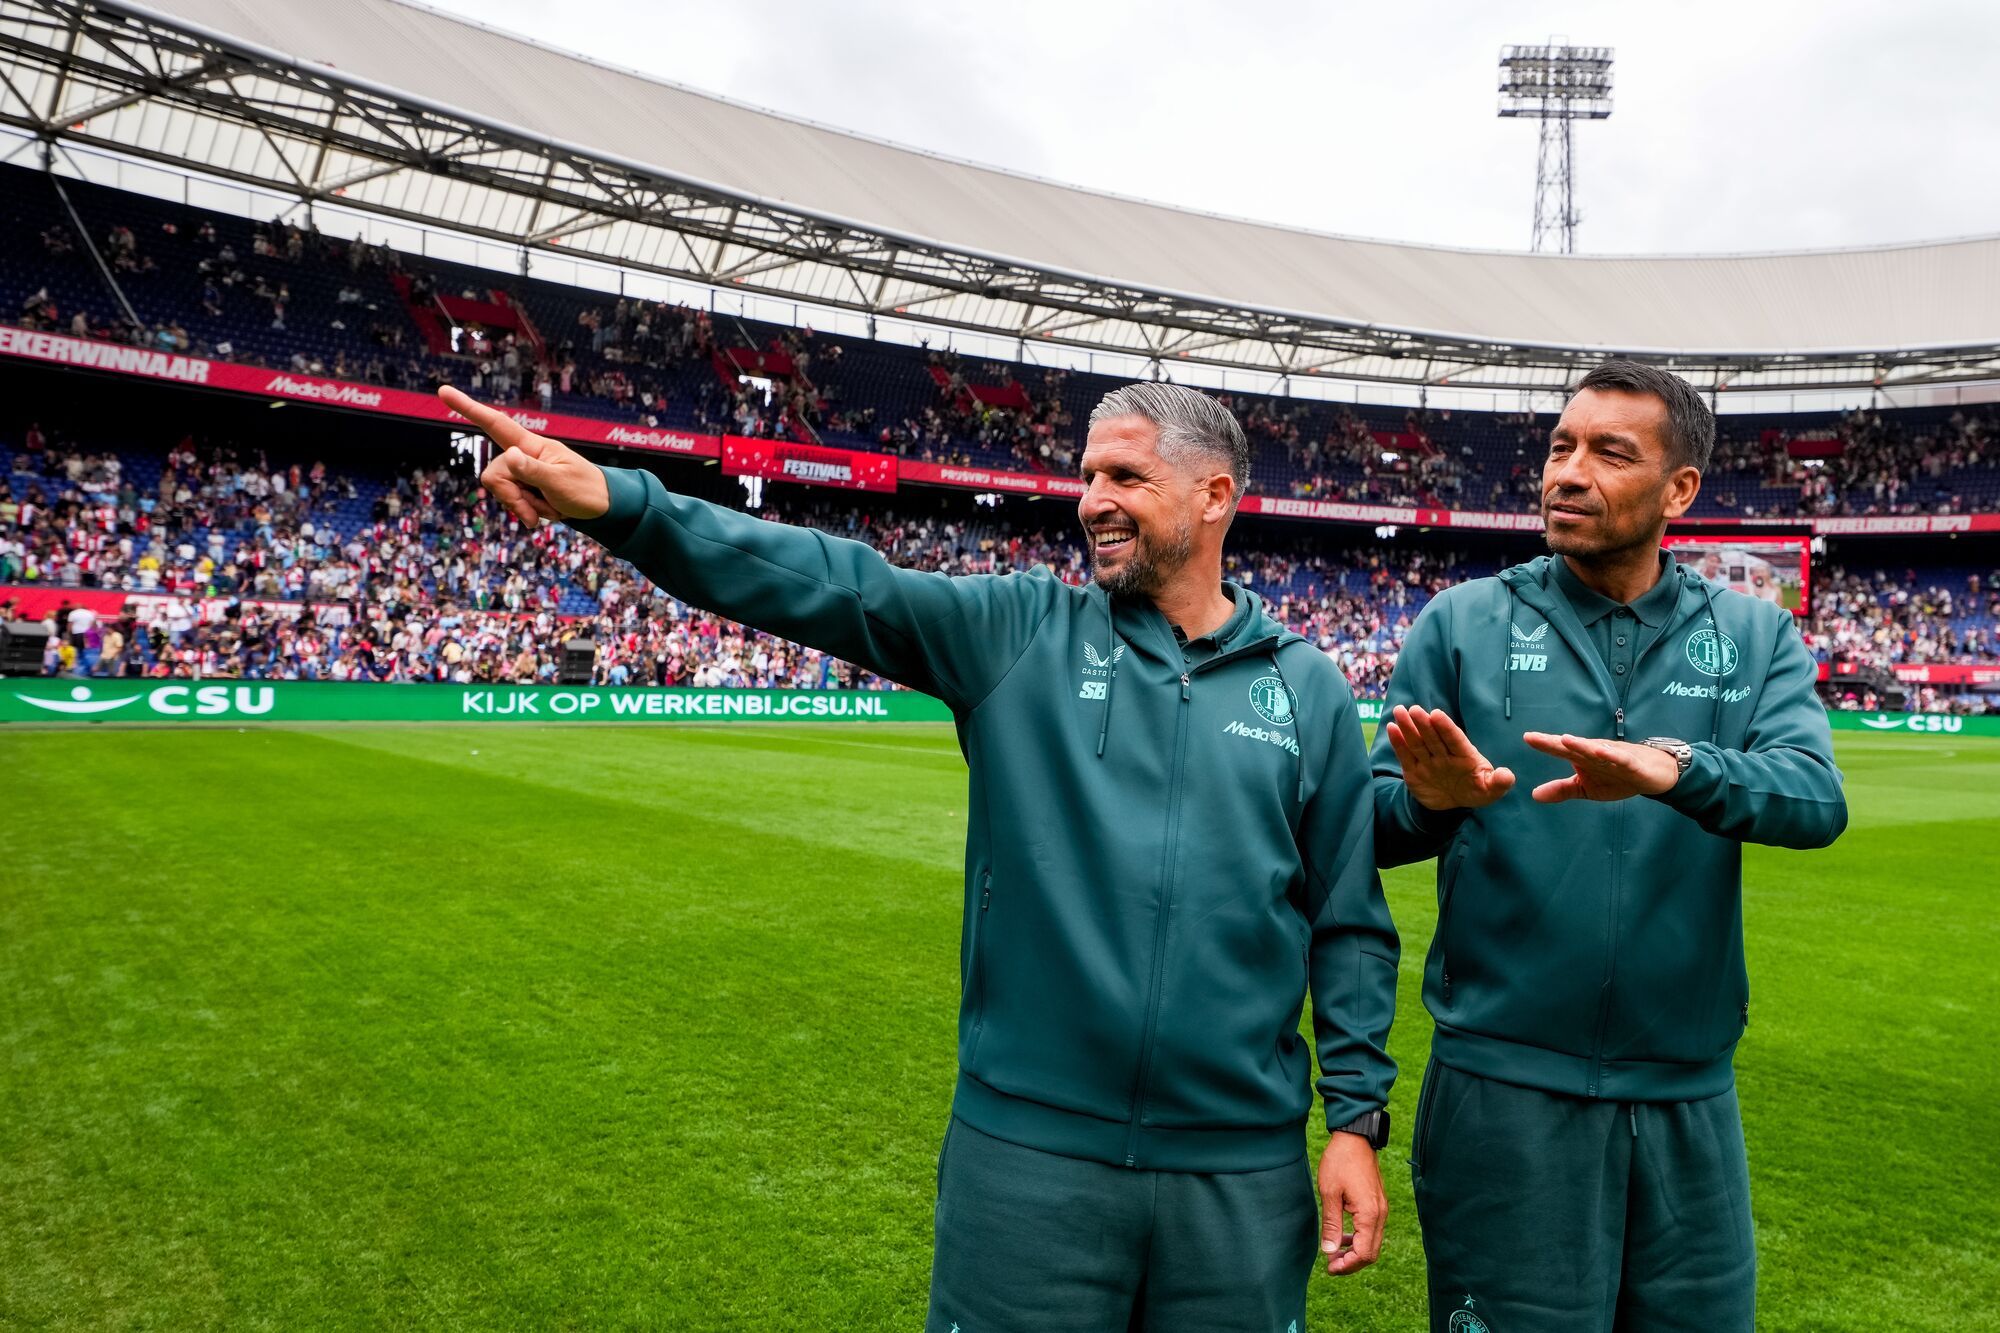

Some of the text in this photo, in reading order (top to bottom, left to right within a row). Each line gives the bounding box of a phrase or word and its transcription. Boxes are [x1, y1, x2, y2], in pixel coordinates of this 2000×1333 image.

[1275, 499, 1309, 517] KEER
[1449, 511, 1514, 529] WINNAAR
[1510, 641, 1546, 650] CASTORE
[1081, 668, 1117, 678] CASTOE
[148, 686, 275, 715] CSU
[463, 692, 889, 716] KIJK OP WERKENBIJCSU.NL
[1907, 715, 1963, 733] CSU
